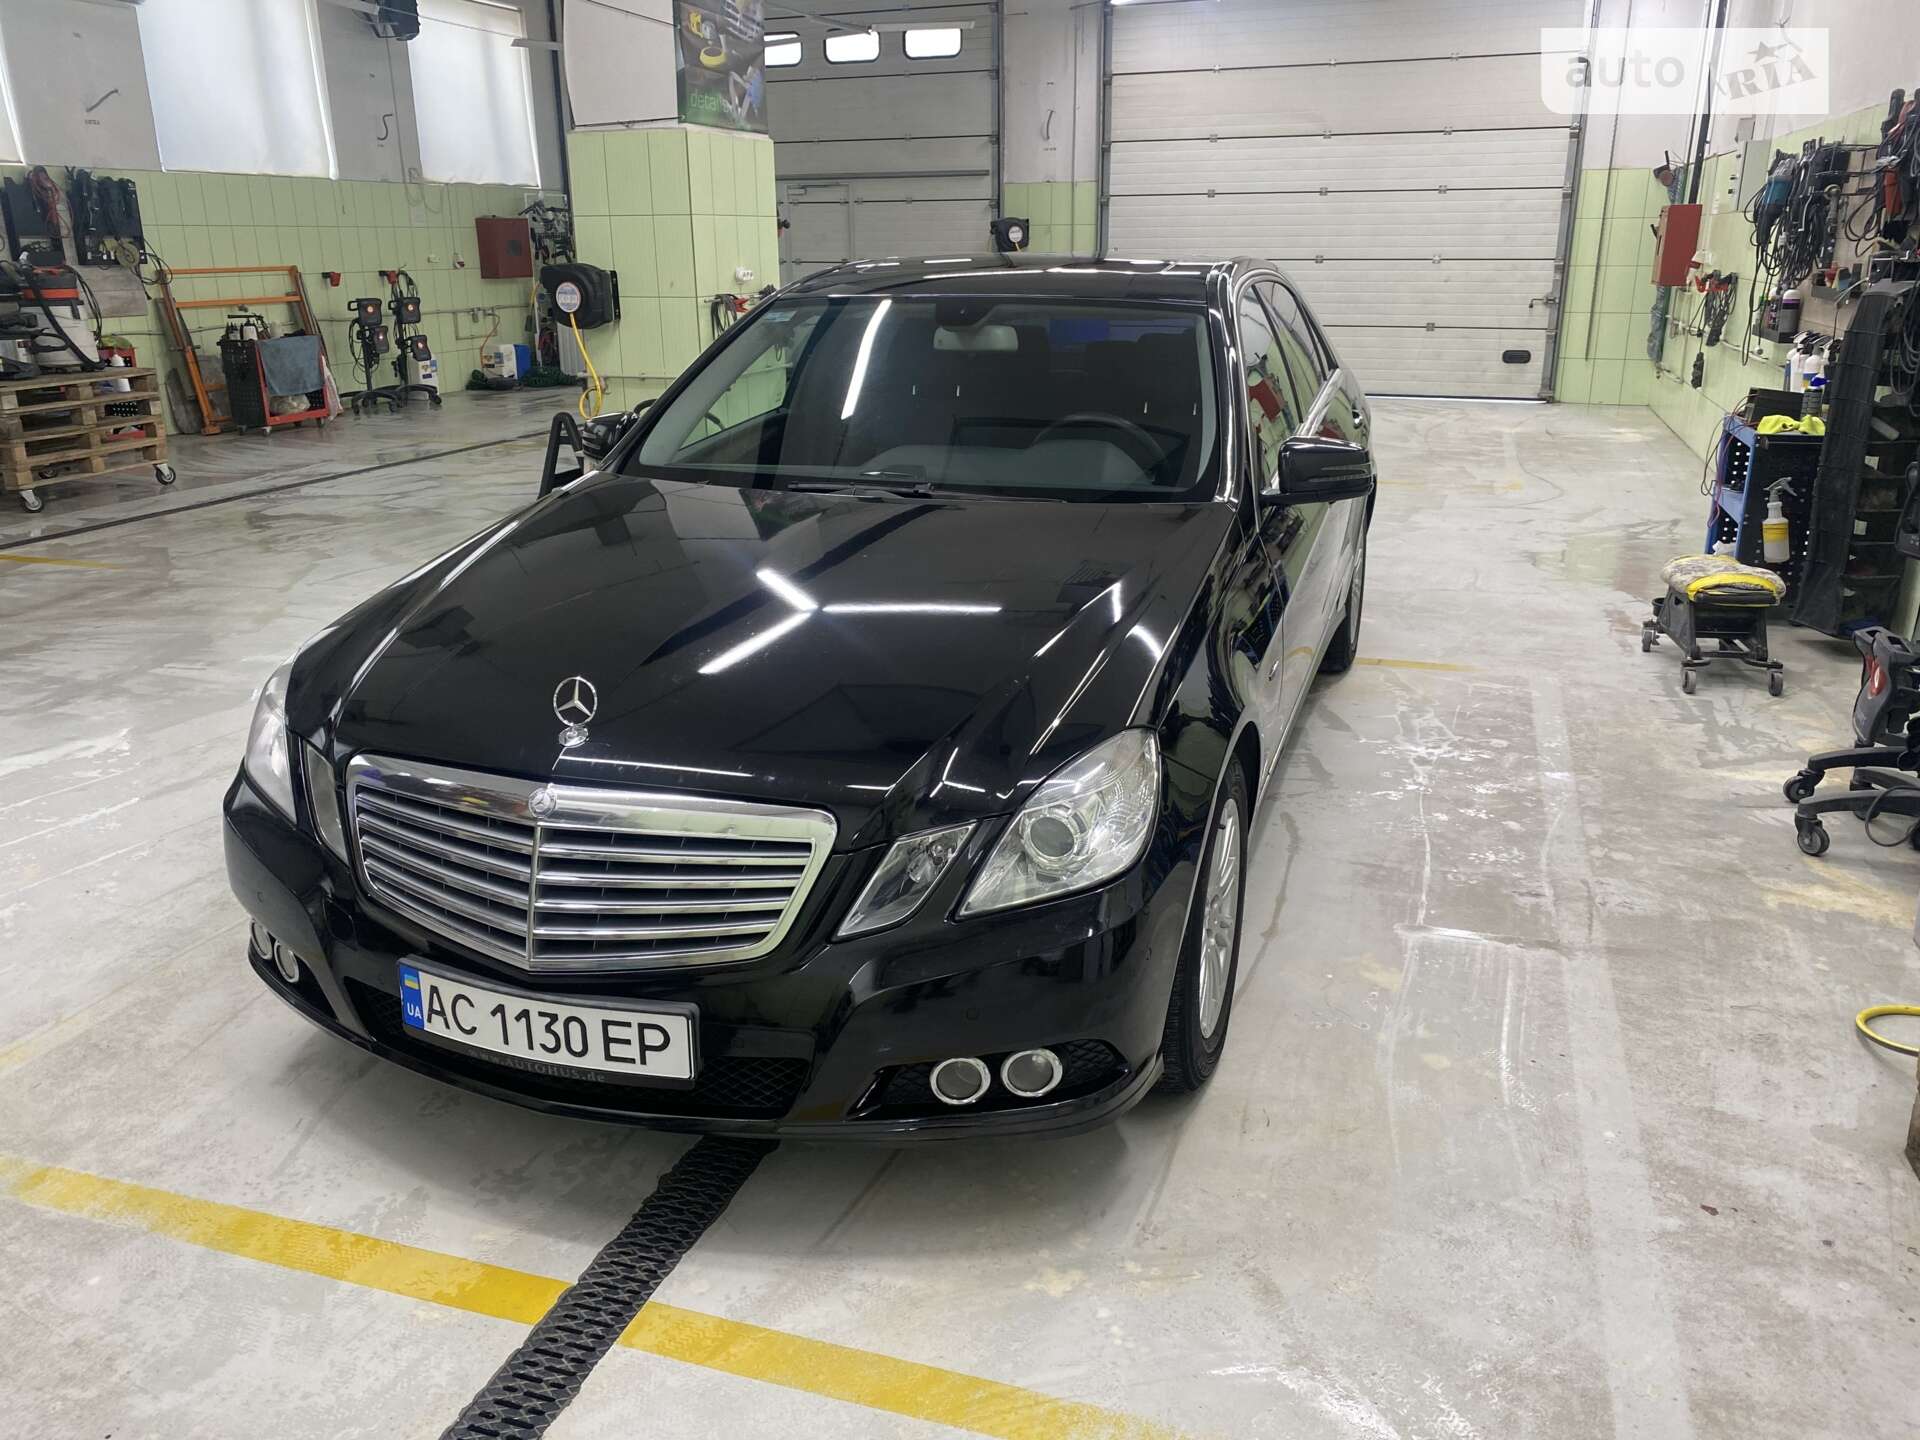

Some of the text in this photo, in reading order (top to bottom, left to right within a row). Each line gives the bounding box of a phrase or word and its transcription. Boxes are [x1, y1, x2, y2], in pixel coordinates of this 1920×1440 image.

[407, 1005, 422, 1020] UA
[426, 984, 671, 1065] AC 1130 EP
